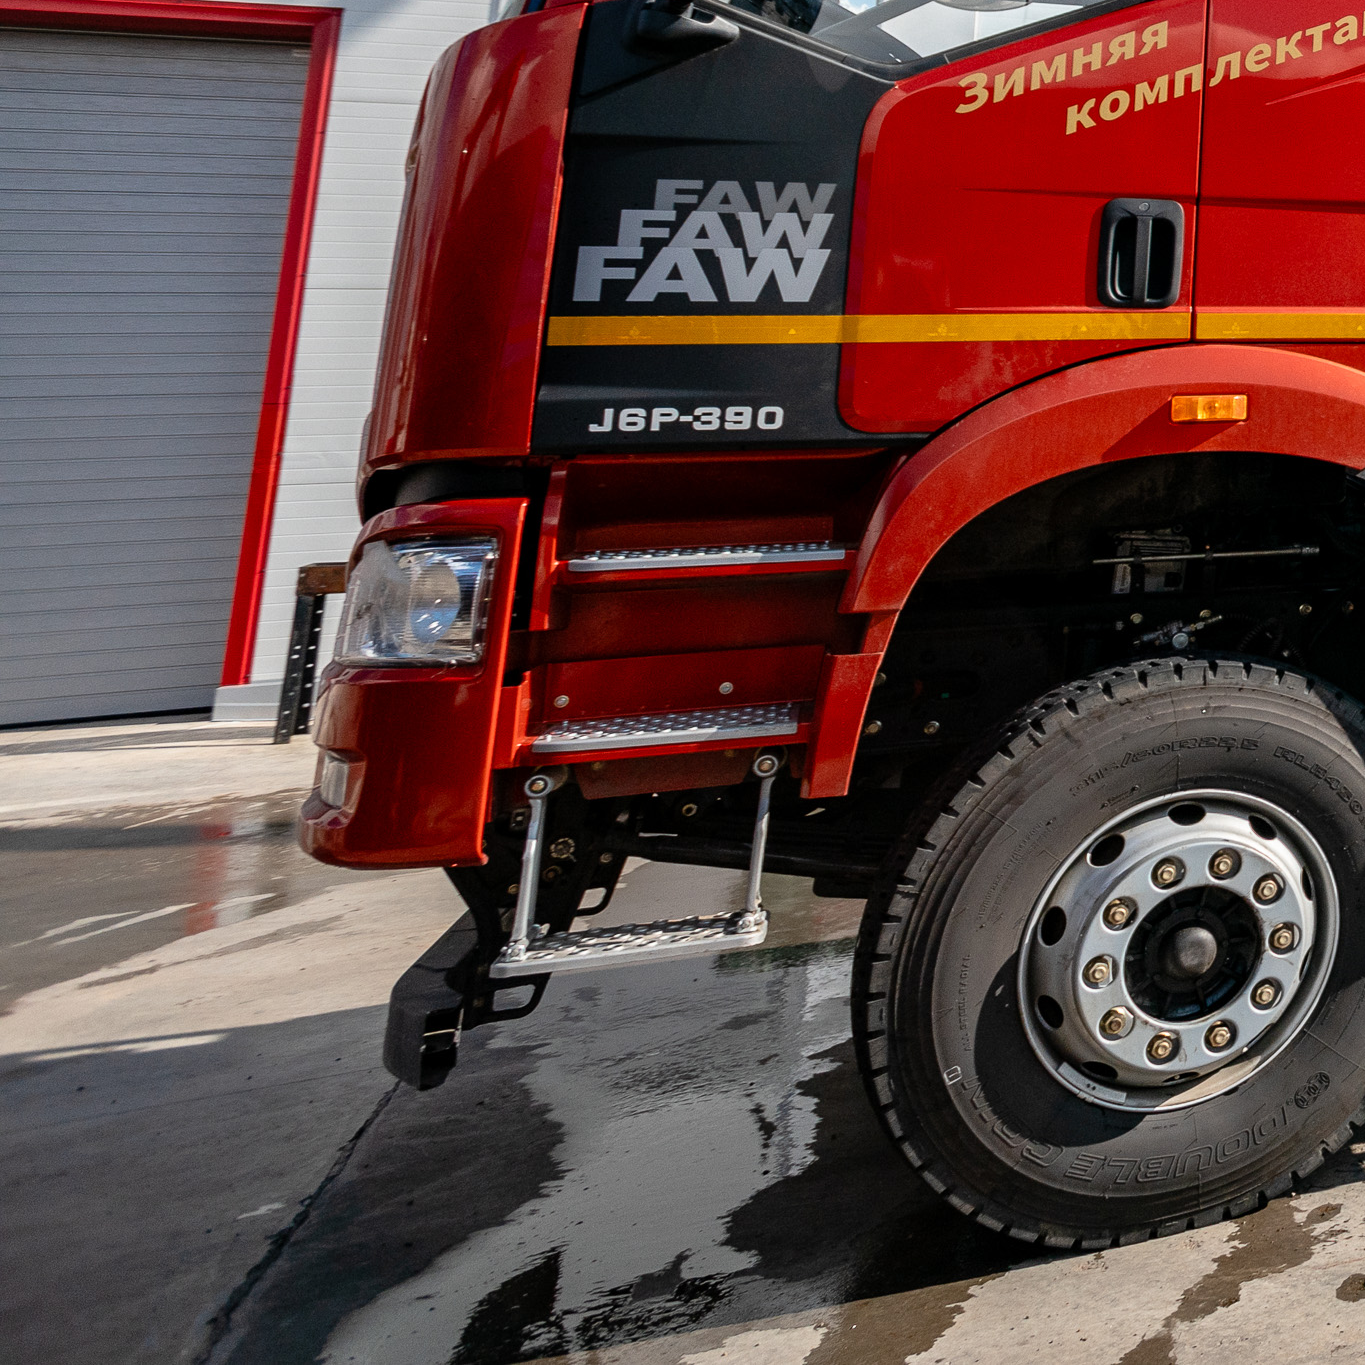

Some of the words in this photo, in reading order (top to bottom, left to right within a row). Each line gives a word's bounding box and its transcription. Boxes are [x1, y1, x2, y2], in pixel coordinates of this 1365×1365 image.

[954, 20, 1169, 114] Зимняя
[654, 179, 837, 221] FAW
[617, 209, 835, 258] FAW
[572, 246, 832, 302] FAW
[588, 406, 785, 432] J6P-390
[1063, 1107, 1289, 1184] DOUBLE
